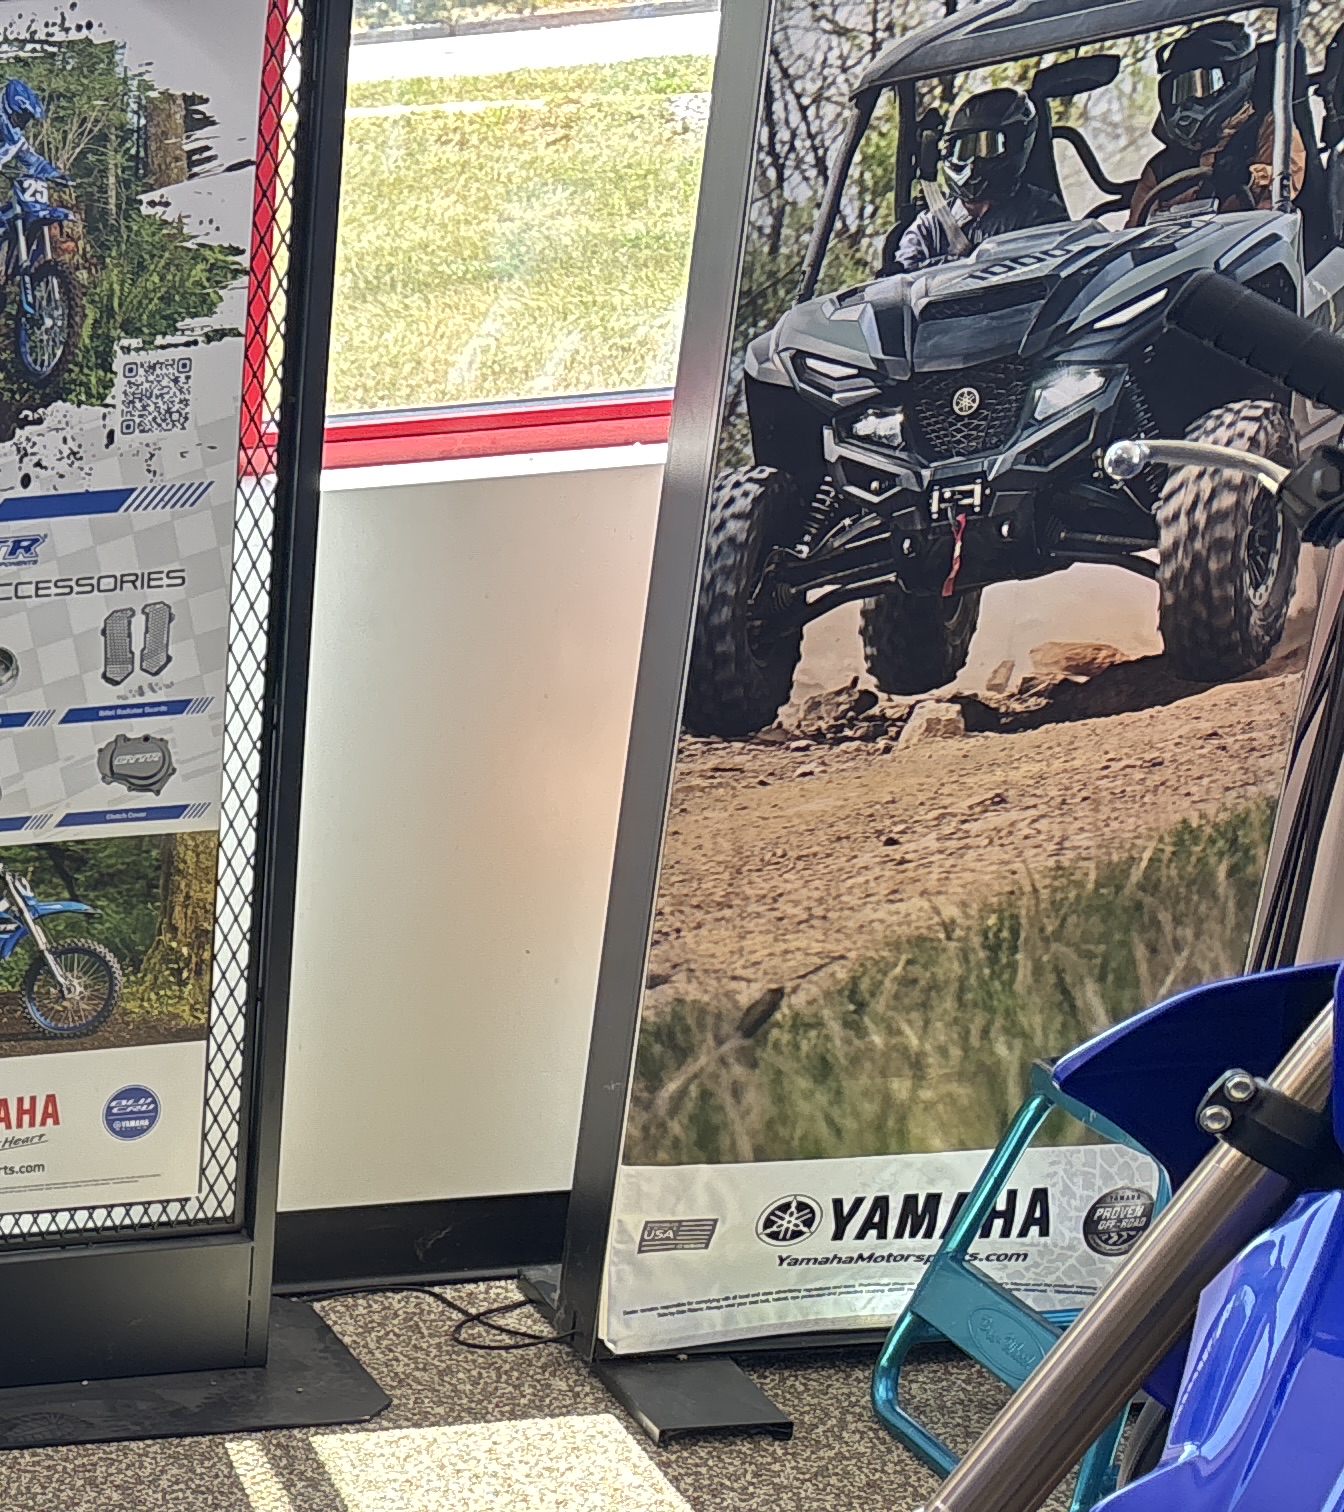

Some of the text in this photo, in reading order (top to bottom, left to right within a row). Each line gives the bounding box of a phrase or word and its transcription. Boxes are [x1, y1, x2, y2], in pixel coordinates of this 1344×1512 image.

[22, 179, 49, 204] 25
[112, 1103, 156, 1114] CRU
[2, 1132, 47, 1150] Heart
[1093, 1205, 1145, 1220] PROVEN
[1097, 1217, 1147, 1230] OFF-ROAD
[643, 1229, 674, 1240] USA
[777, 1250, 1029, 1268] YamahaMotorspts.com
